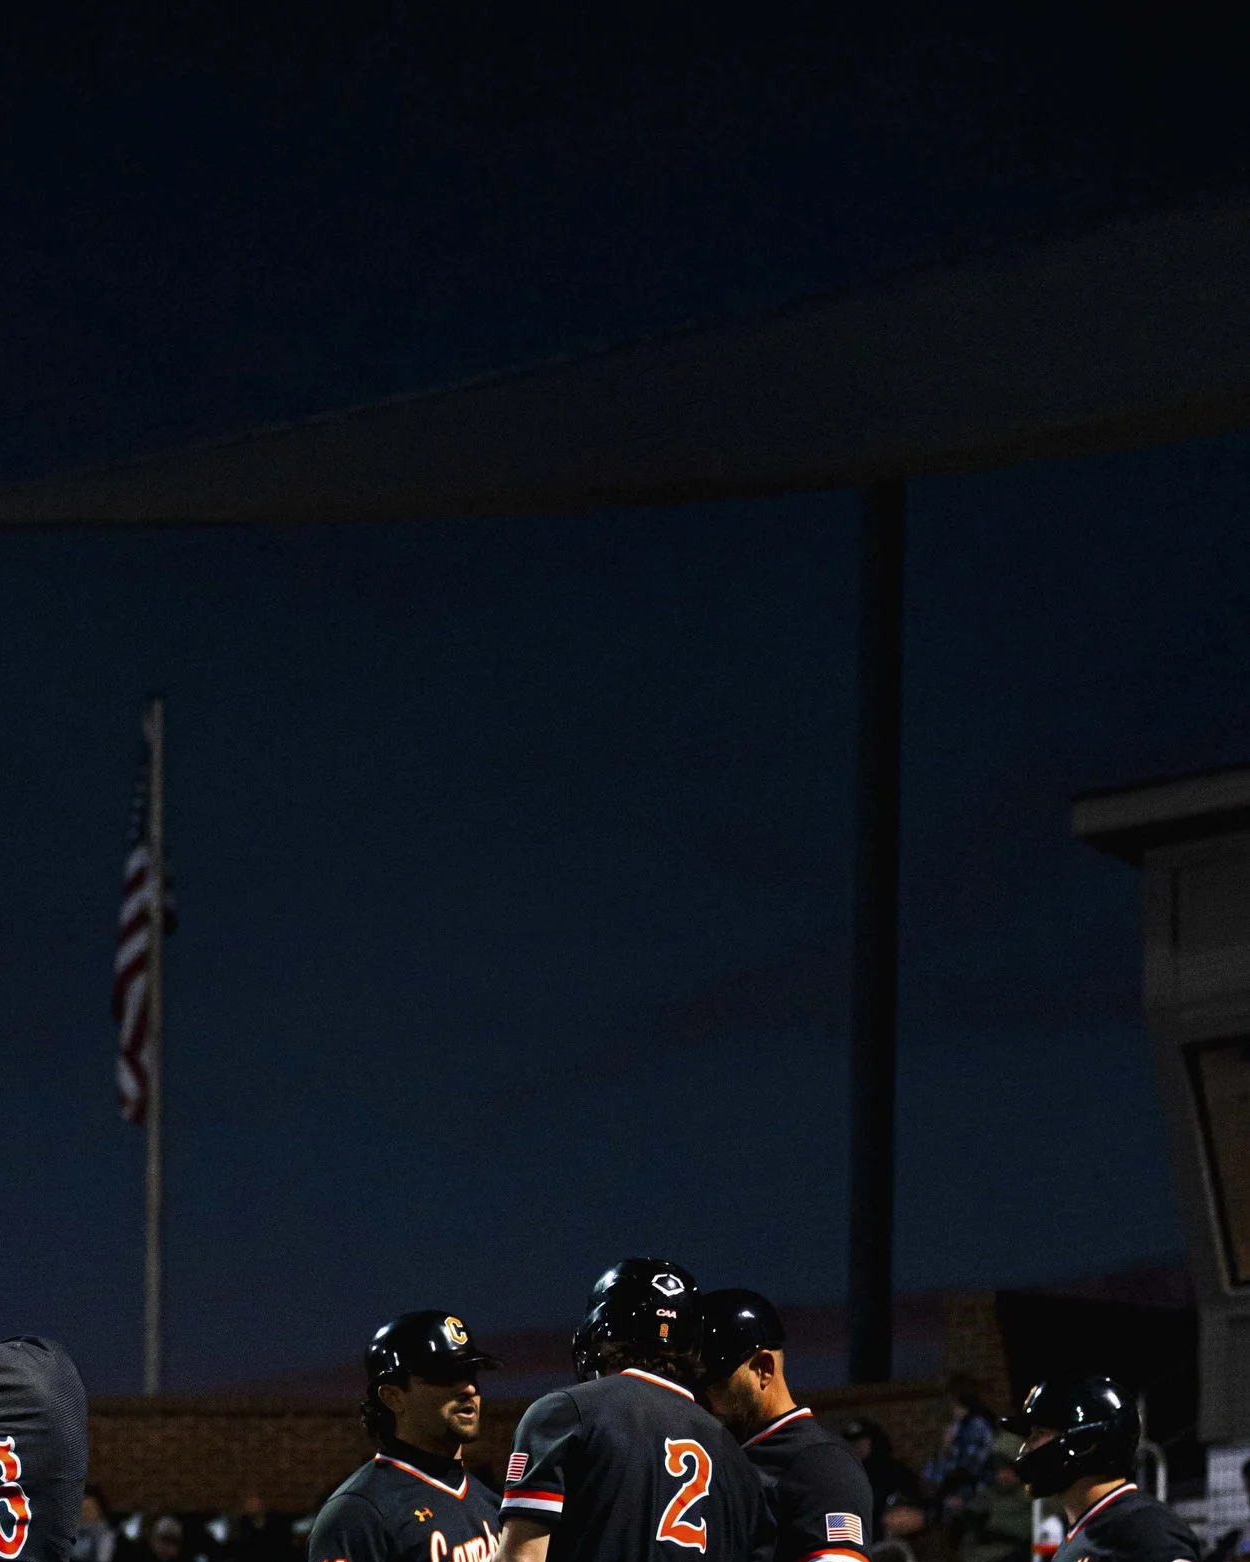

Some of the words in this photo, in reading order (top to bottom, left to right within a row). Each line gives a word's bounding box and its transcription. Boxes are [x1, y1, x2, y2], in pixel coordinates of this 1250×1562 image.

[656, 1308, 677, 1319] CAA
[444, 1316, 468, 1345] C
[656, 1437, 712, 1554] 2
